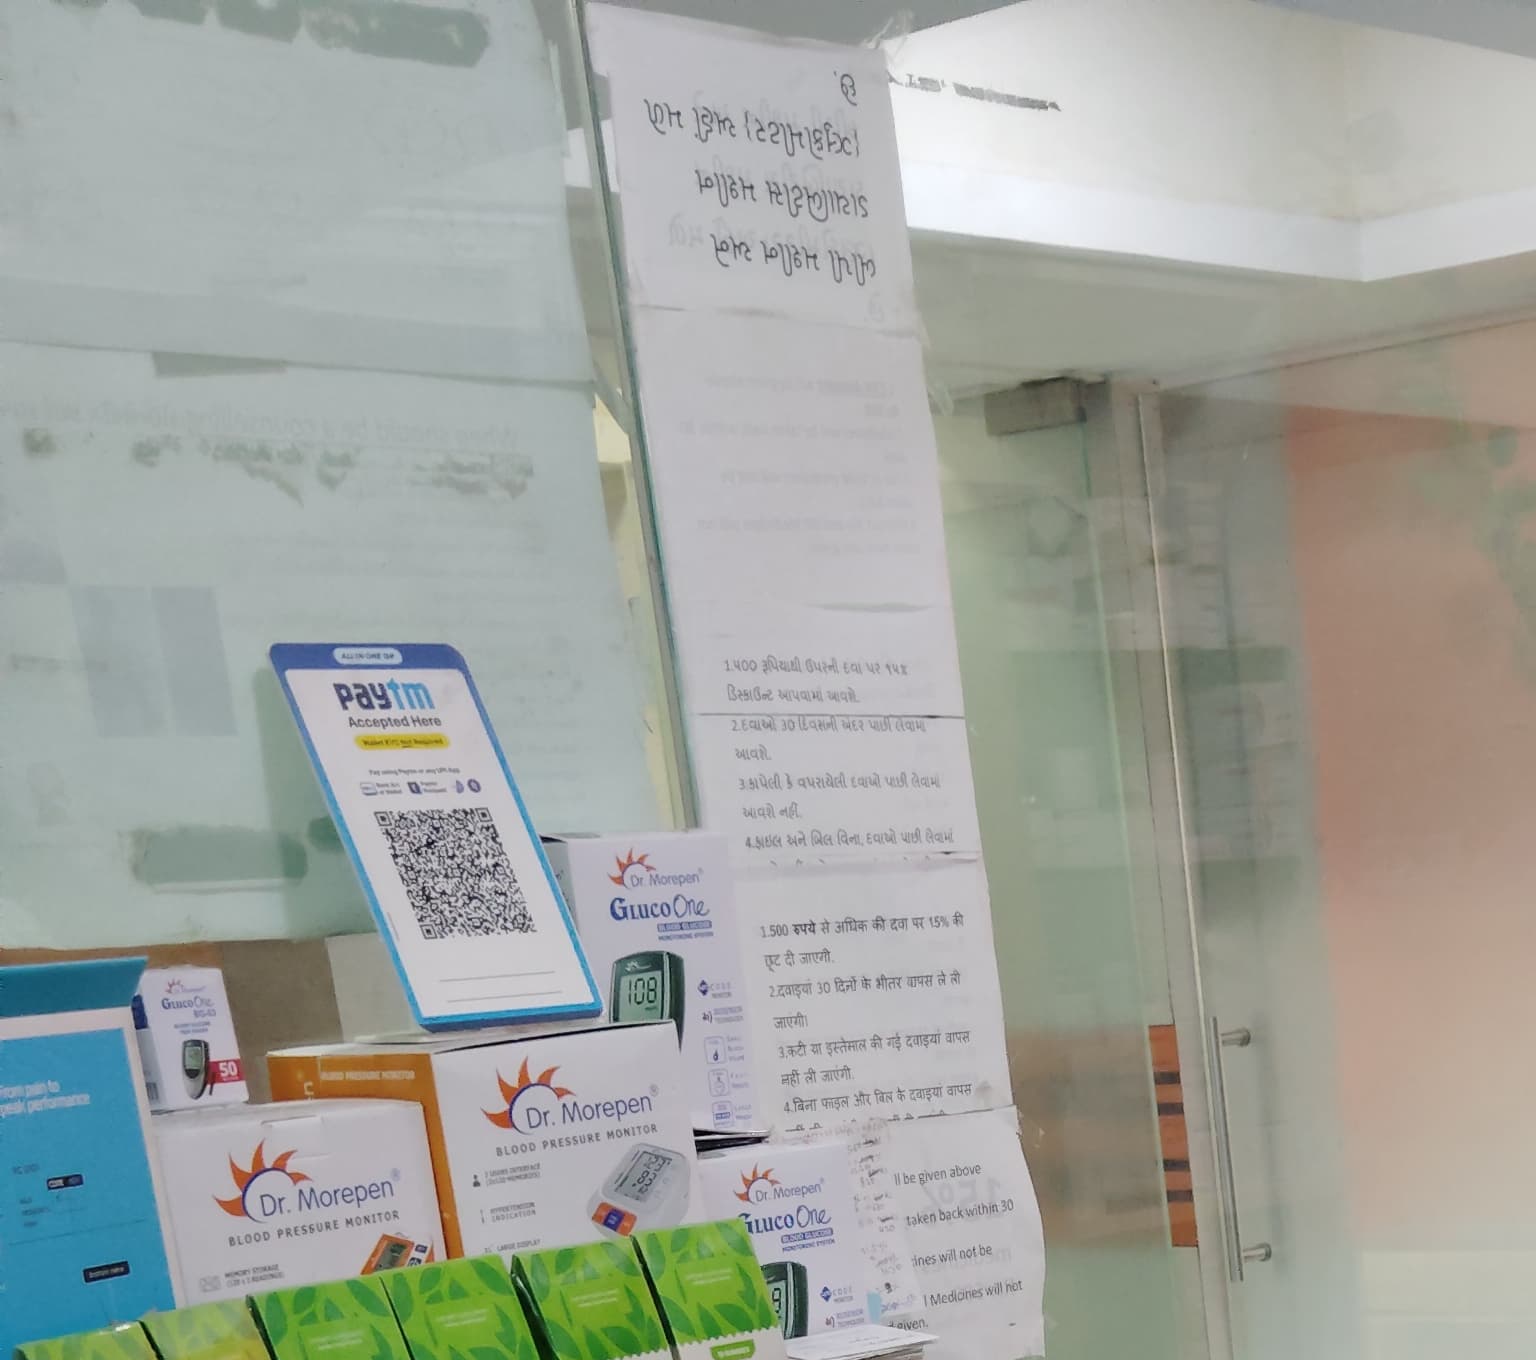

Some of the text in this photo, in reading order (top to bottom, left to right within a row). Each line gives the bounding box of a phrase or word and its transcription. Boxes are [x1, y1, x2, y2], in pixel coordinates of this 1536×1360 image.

[643, 99, 684, 134] મળે
[692, 106, 737, 143] અહીં
[695, 169, 870, 222] ડાયાબિટીસ મશીન
[710, 233, 876, 286] બીપી મશીન અને
[843, 661, 863, 675] દવા
[349, 716, 442, 729] Accepted Here
[649, 873, 701, 887] Morepen
[792, 919, 817, 936] रुपये
[821, 918, 830, 934] से
[834, 917, 868, 934] अधिक
[872, 916, 886, 931] की
[890, 917, 909, 931] दवा
[912, 916, 925, 930] पर
[929, 915, 949, 929] 15%
[952, 911, 964, 927] की
[784, 950, 795, 967] दी
[626, 976, 658, 1006] 108
[817, 981, 831, 995] 30
[834, 976, 857, 993] दिनों
[861, 976, 871, 991] के
[876, 973, 903, 992] भीतर
[907, 973, 933, 988] वापस
[811, 1043, 823, 1056] या
[826, 1037, 867, 1058] इस्तेमाल
[870, 1033, 883, 1049] की
[886, 1032, 902, 1052] गई
[946, 1030, 970, 1044] वापस
[219, 1062, 238, 1076] 50
[781, 1069, 800, 1087] नहीं
[804, 1068, 817, 1084] ली
[854, 1090, 872, 1107] और
[897, 1087, 906, 1102] के
[947, 1083, 972, 1097] वापस
[526, 1095, 653, 1129] Dr. Morepen
[495, 1123, 658, 1157] BLOOD PRESSURE MONITOR
[904, 1163, 982, 1187] be given above
[260, 1180, 394, 1218] Dr. Morepen
[755, 1183, 822, 1202] Dr. Morepen
[906, 1198, 1014, 1227] taken back within 30
[228, 1210, 400, 1248] BLOOD PRESSURE MONITOR
[939, 1250, 956, 1264] will
[959, 1247, 977, 1260] not
[980, 1244, 992, 1256] be
[930, 1280, 1023, 1306] Medicines will not
